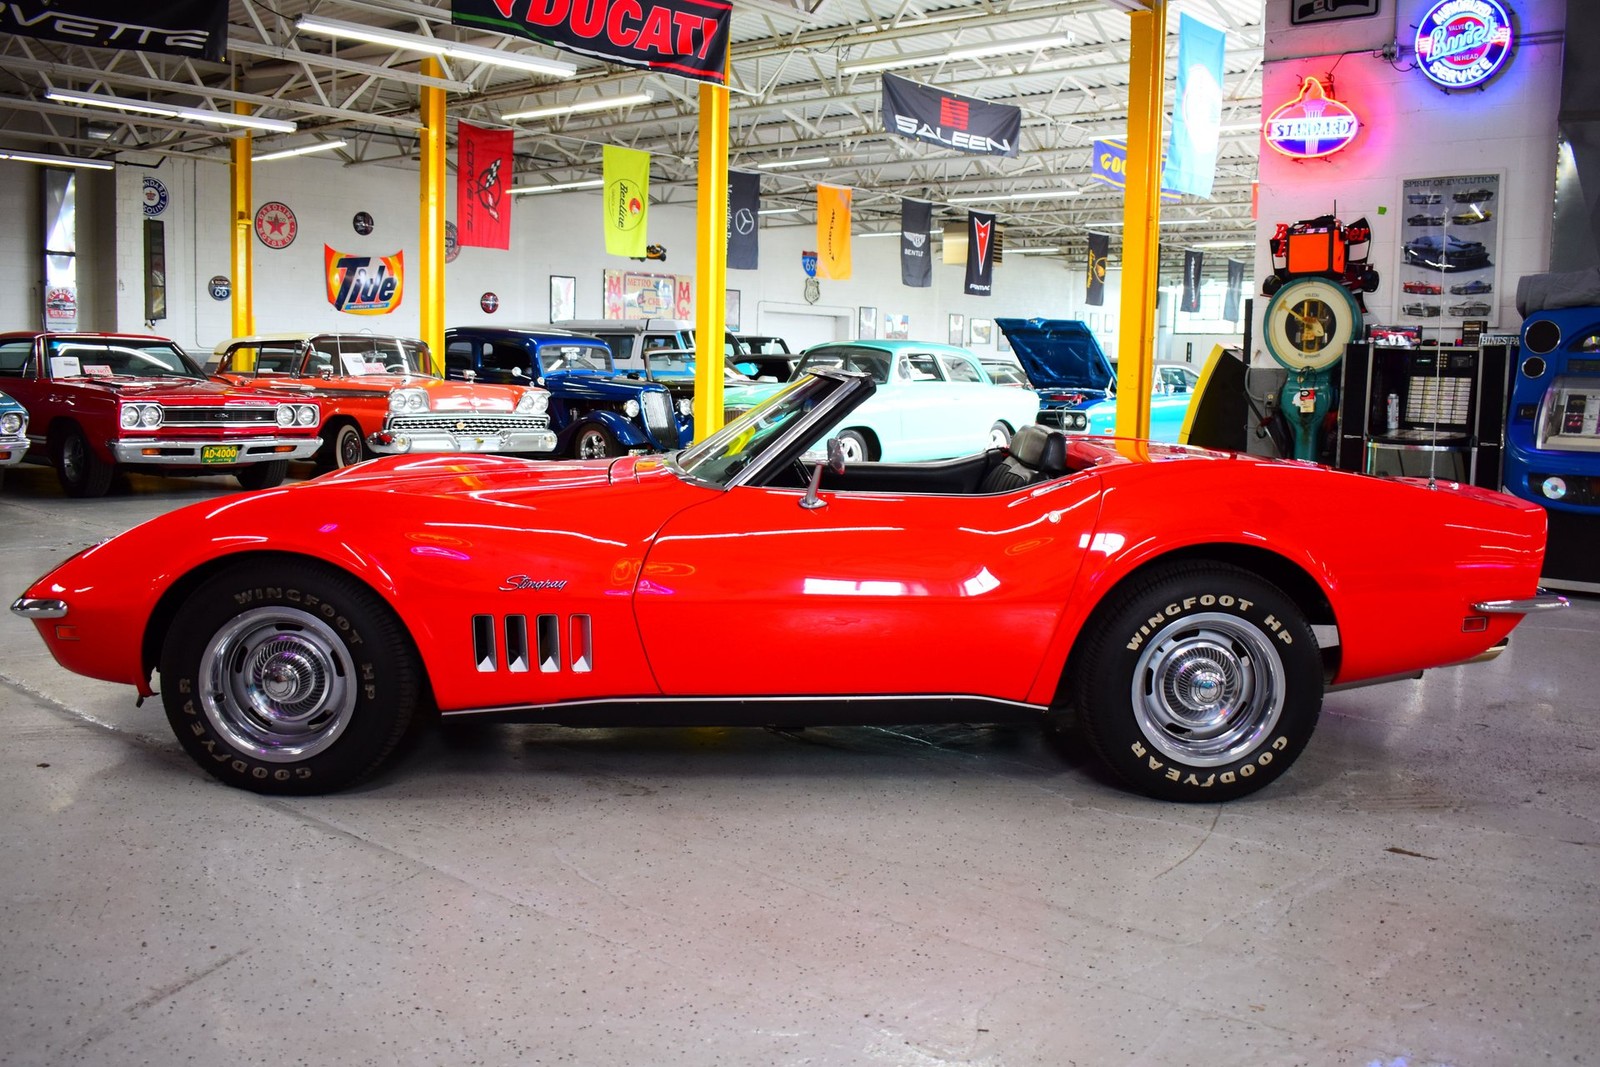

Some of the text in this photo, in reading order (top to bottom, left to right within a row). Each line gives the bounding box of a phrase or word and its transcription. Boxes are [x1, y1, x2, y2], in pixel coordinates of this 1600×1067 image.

[0, 3, 210, 50] VETTE
[526, 0, 718, 60] DUCATI
[1425, 16, 1500, 62] Buick
[1429, 57, 1493, 83] SERVICE
[1461, 53, 1479, 61] HEAD
[895, 114, 1011, 151] SALEEN
[1274, 120, 1354, 137] STANDARD
[466, 138, 475, 232] CORVETTE
[1404, 175, 1499, 188] SPIRIT OF EVOLUTION
[258, 204, 294, 222] GASOLINE
[618, 182, 628, 228] Beeline
[257, 228, 295, 246] MOTOR OIL
[215, 286, 228, 297] 66
[335, 257, 398, 311] Tide
[627, 280, 652, 288] METRO
[1481, 334, 1508, 345] HINES
[205, 449, 237, 458] AD-4000
[498, 574, 568, 591] Stingray
[1126, 594, 1293, 651] WINGFOOT HP
[233, 587, 375, 700] WINGFOOT HP
[178, 677, 313, 781] GOODYEAR
[1130, 735, 1288, 788] GOODYEAR
